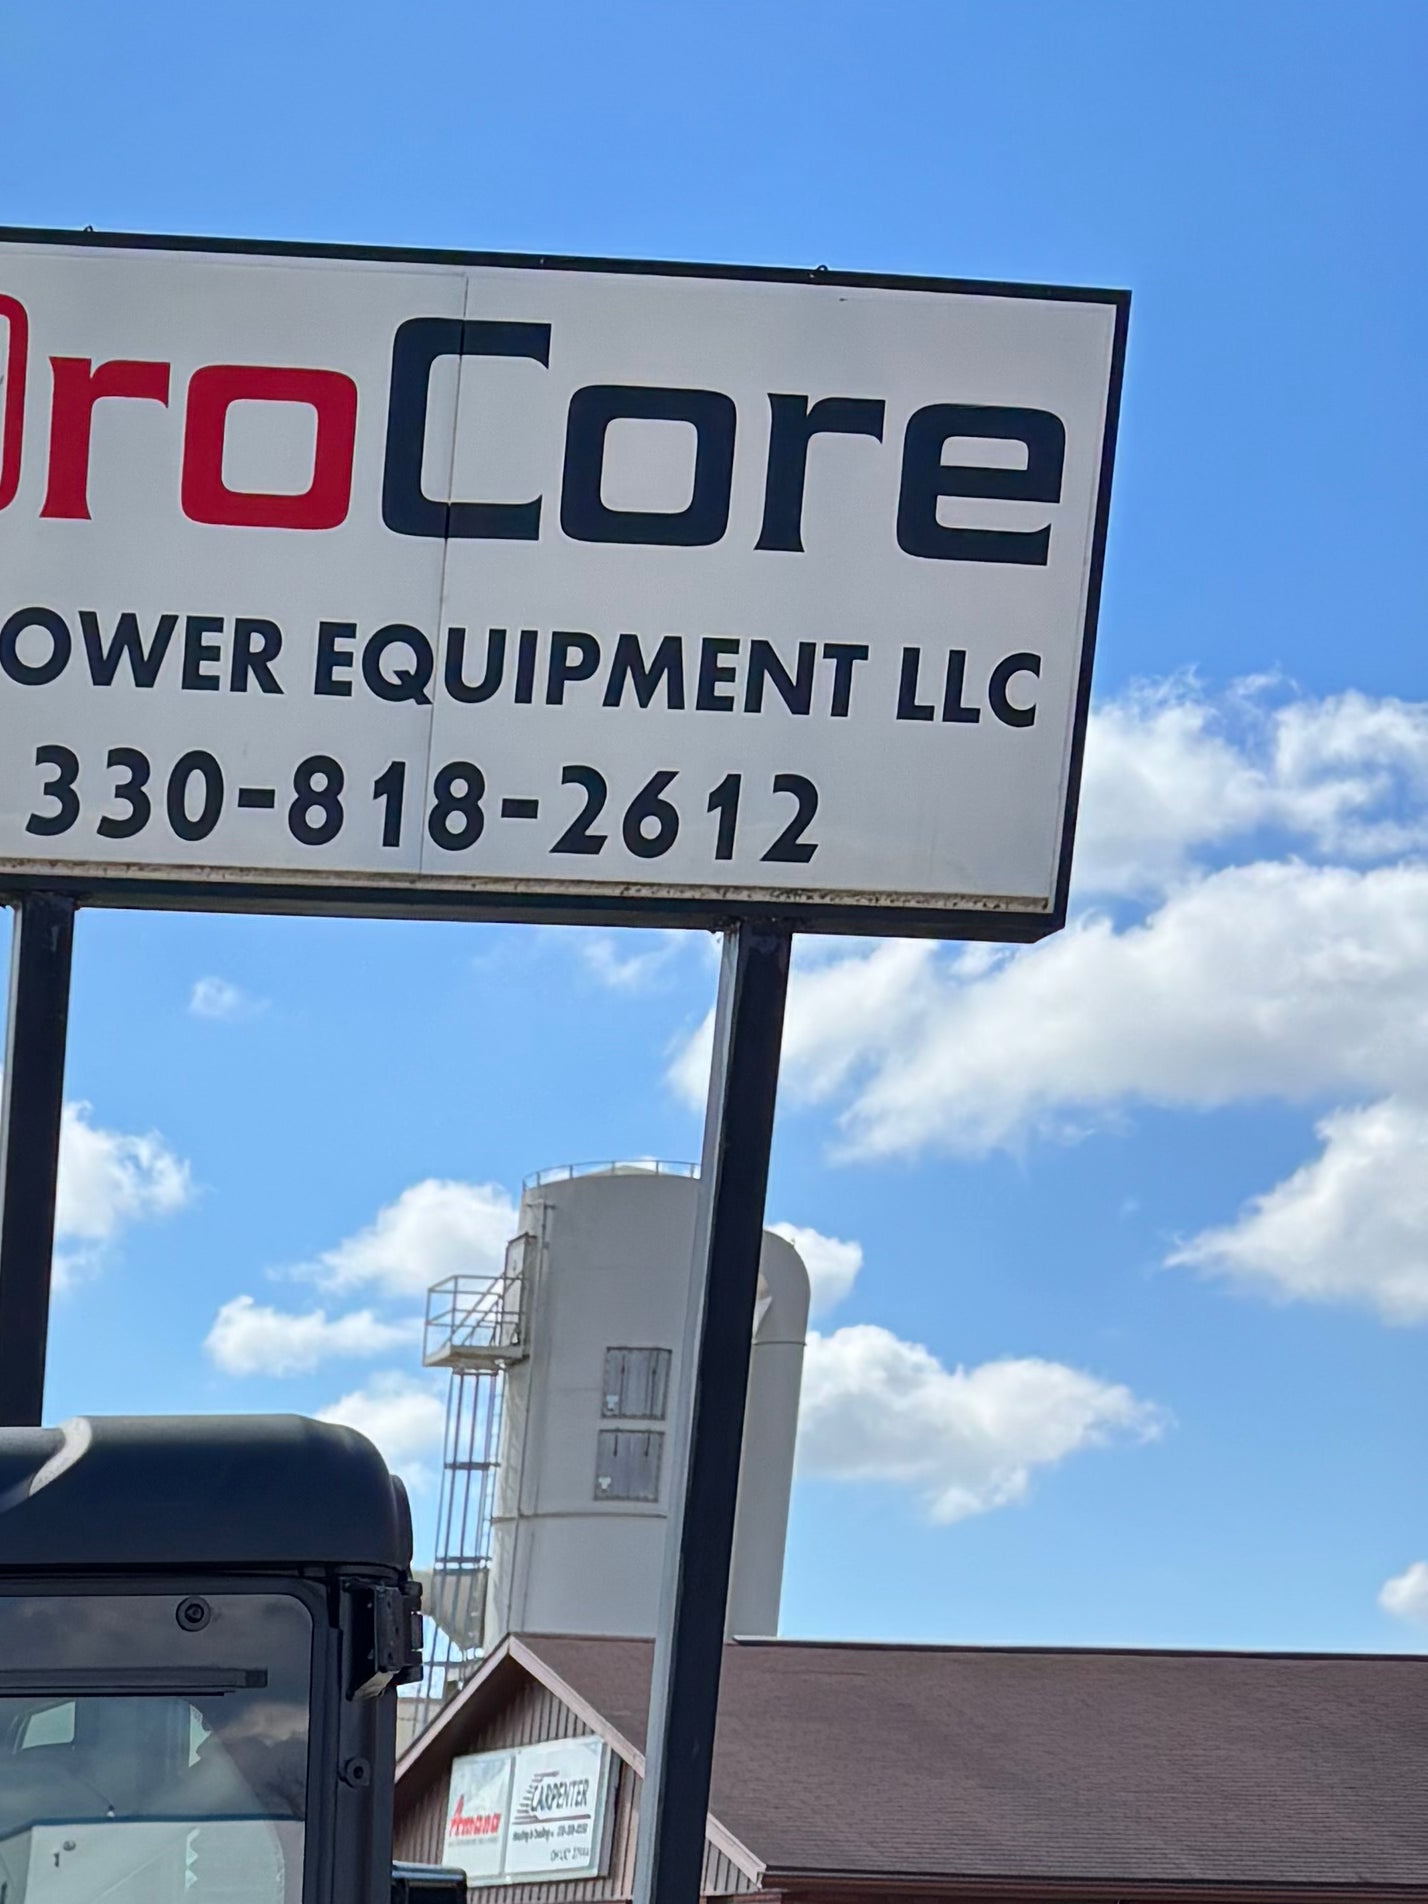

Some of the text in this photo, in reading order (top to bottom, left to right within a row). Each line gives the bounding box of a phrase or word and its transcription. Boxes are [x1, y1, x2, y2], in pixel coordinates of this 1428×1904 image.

[314, 622, 869, 717] EQUIPMENT
[896, 647, 1041, 727] LLC
[26, 745, 818, 863] 330-818-2612
[531, 1778, 590, 1813] CARPENTER
